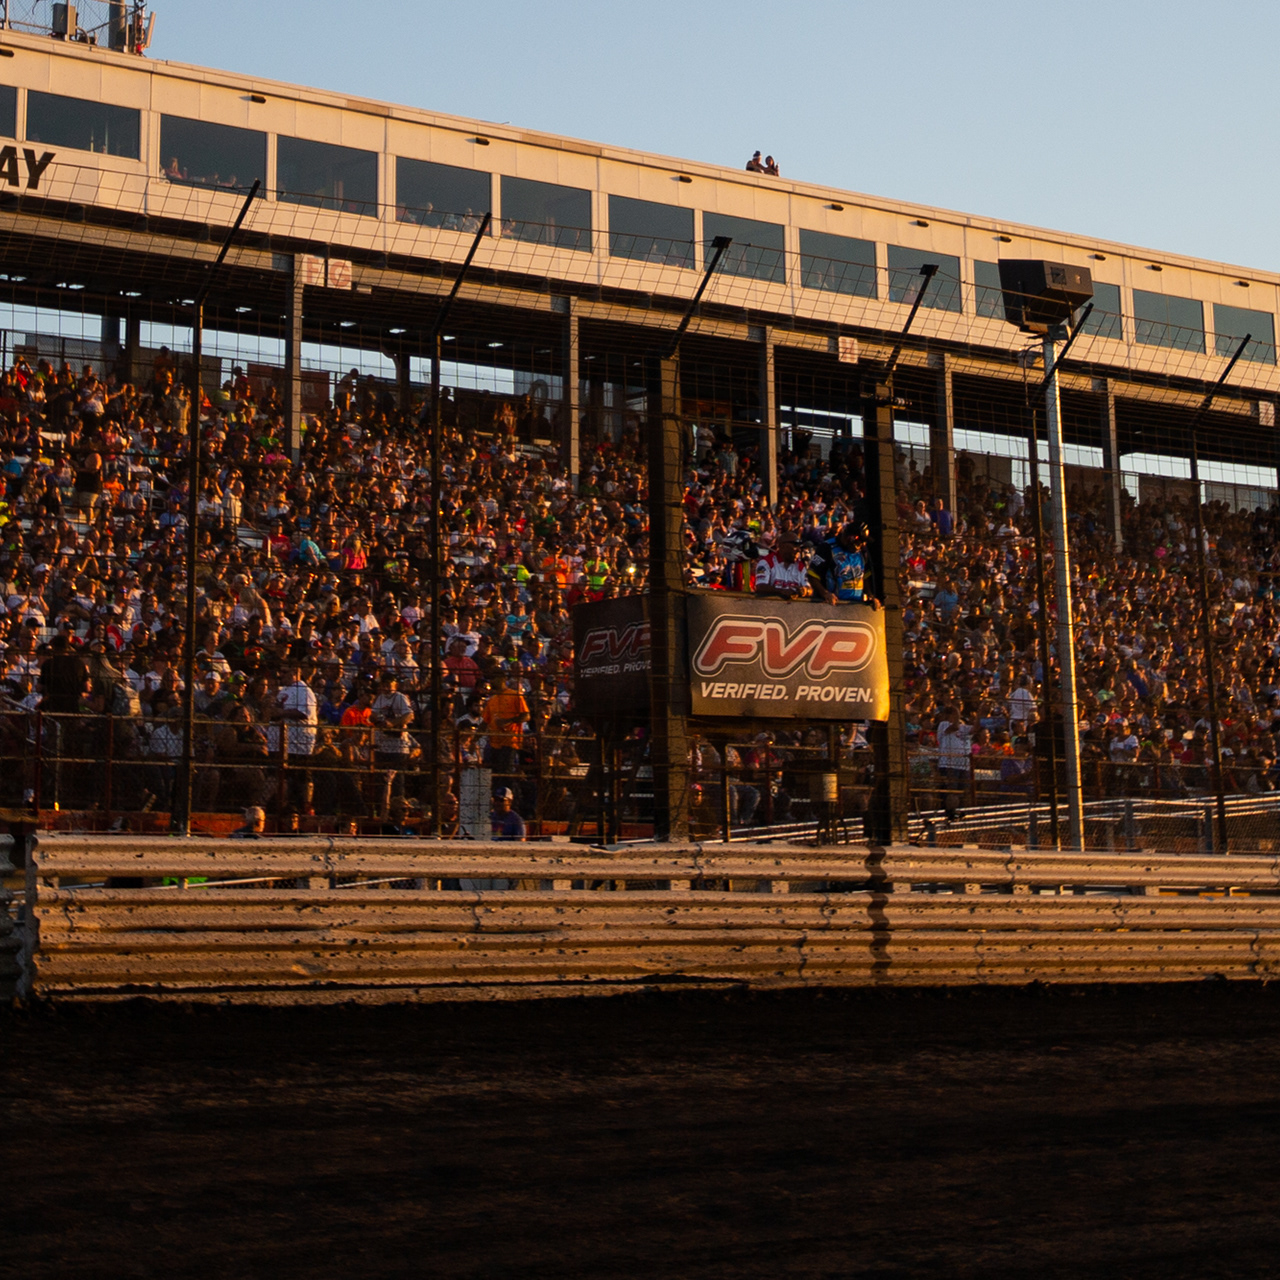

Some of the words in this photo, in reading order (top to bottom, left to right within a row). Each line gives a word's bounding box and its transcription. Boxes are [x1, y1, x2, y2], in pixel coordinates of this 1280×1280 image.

[307, 257, 320, 284] F
[329, 261, 350, 287] G
[698, 620, 873, 676] FVP
[701, 682, 789, 700] VERIFIED.
[795, 685, 874, 703] PROVEN.
